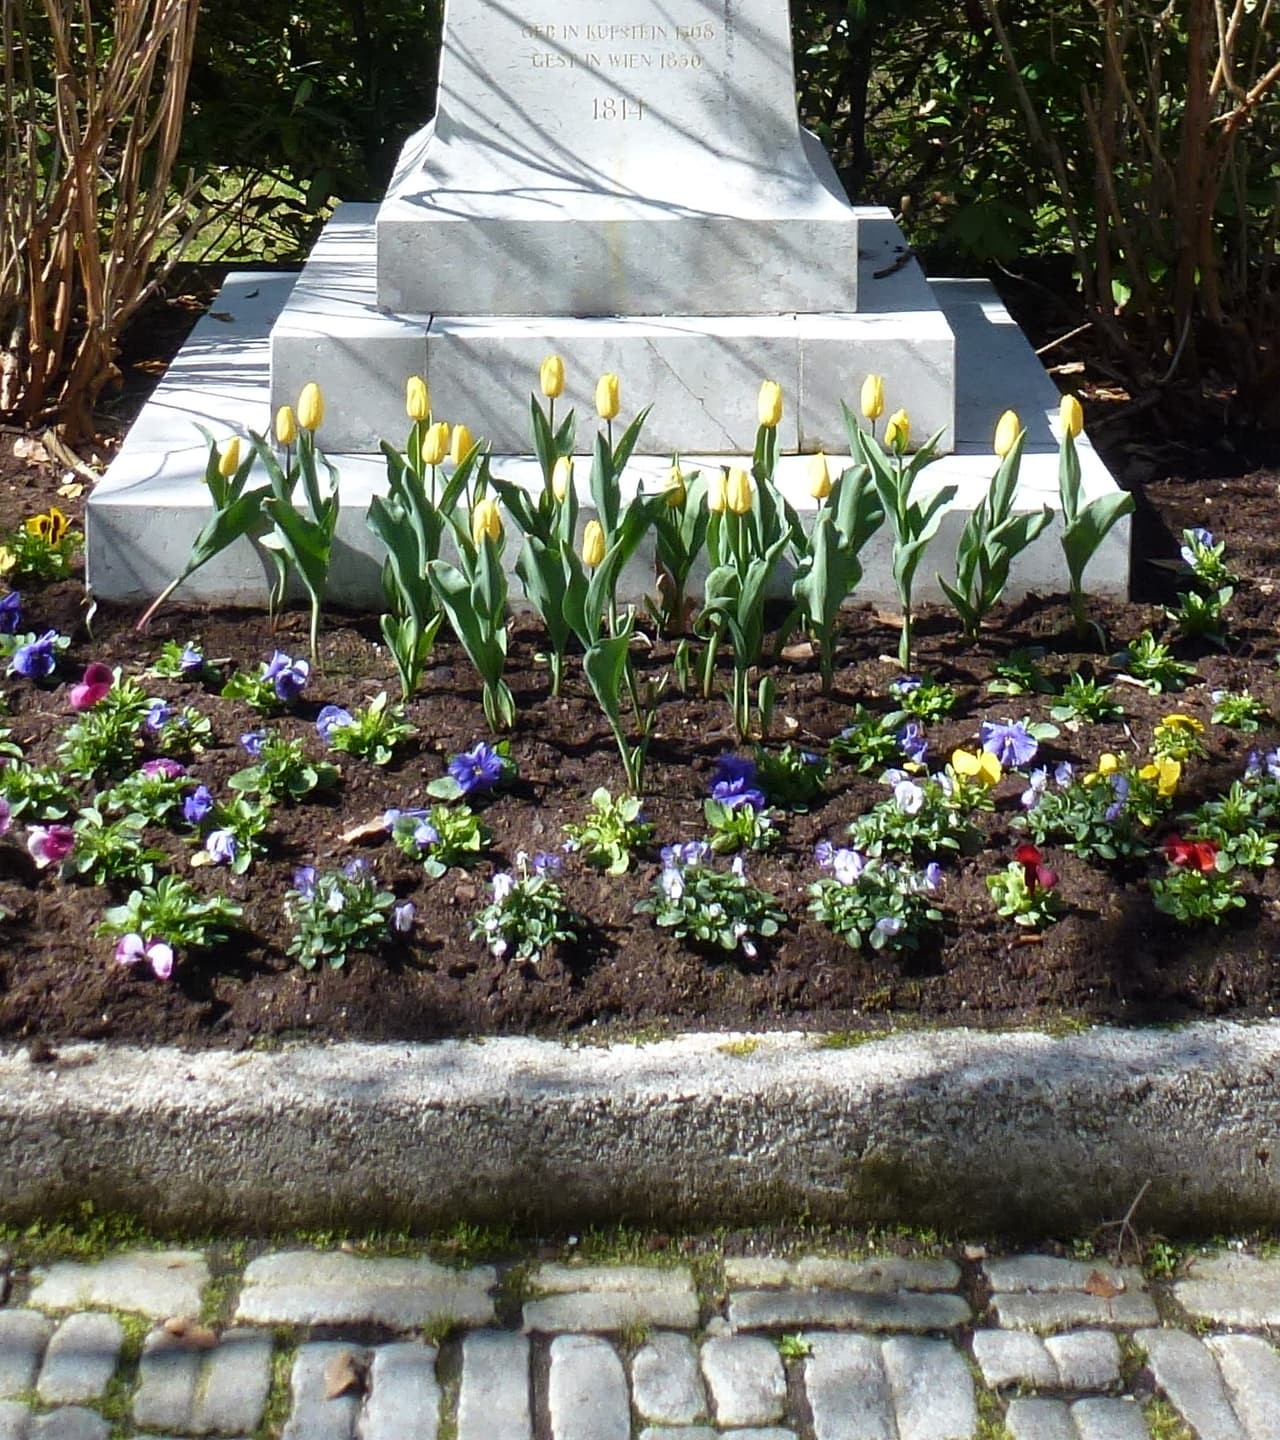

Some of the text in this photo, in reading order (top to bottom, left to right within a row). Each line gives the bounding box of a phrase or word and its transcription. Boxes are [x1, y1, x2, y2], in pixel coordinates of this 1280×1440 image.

[562, 25, 578, 40] IN
[586, 24, 667, 41] KUFSTEIN
[585, 53, 601, 68] IN
[608, 53, 651, 69] WIEN
[593, 97, 646, 121] 1814
